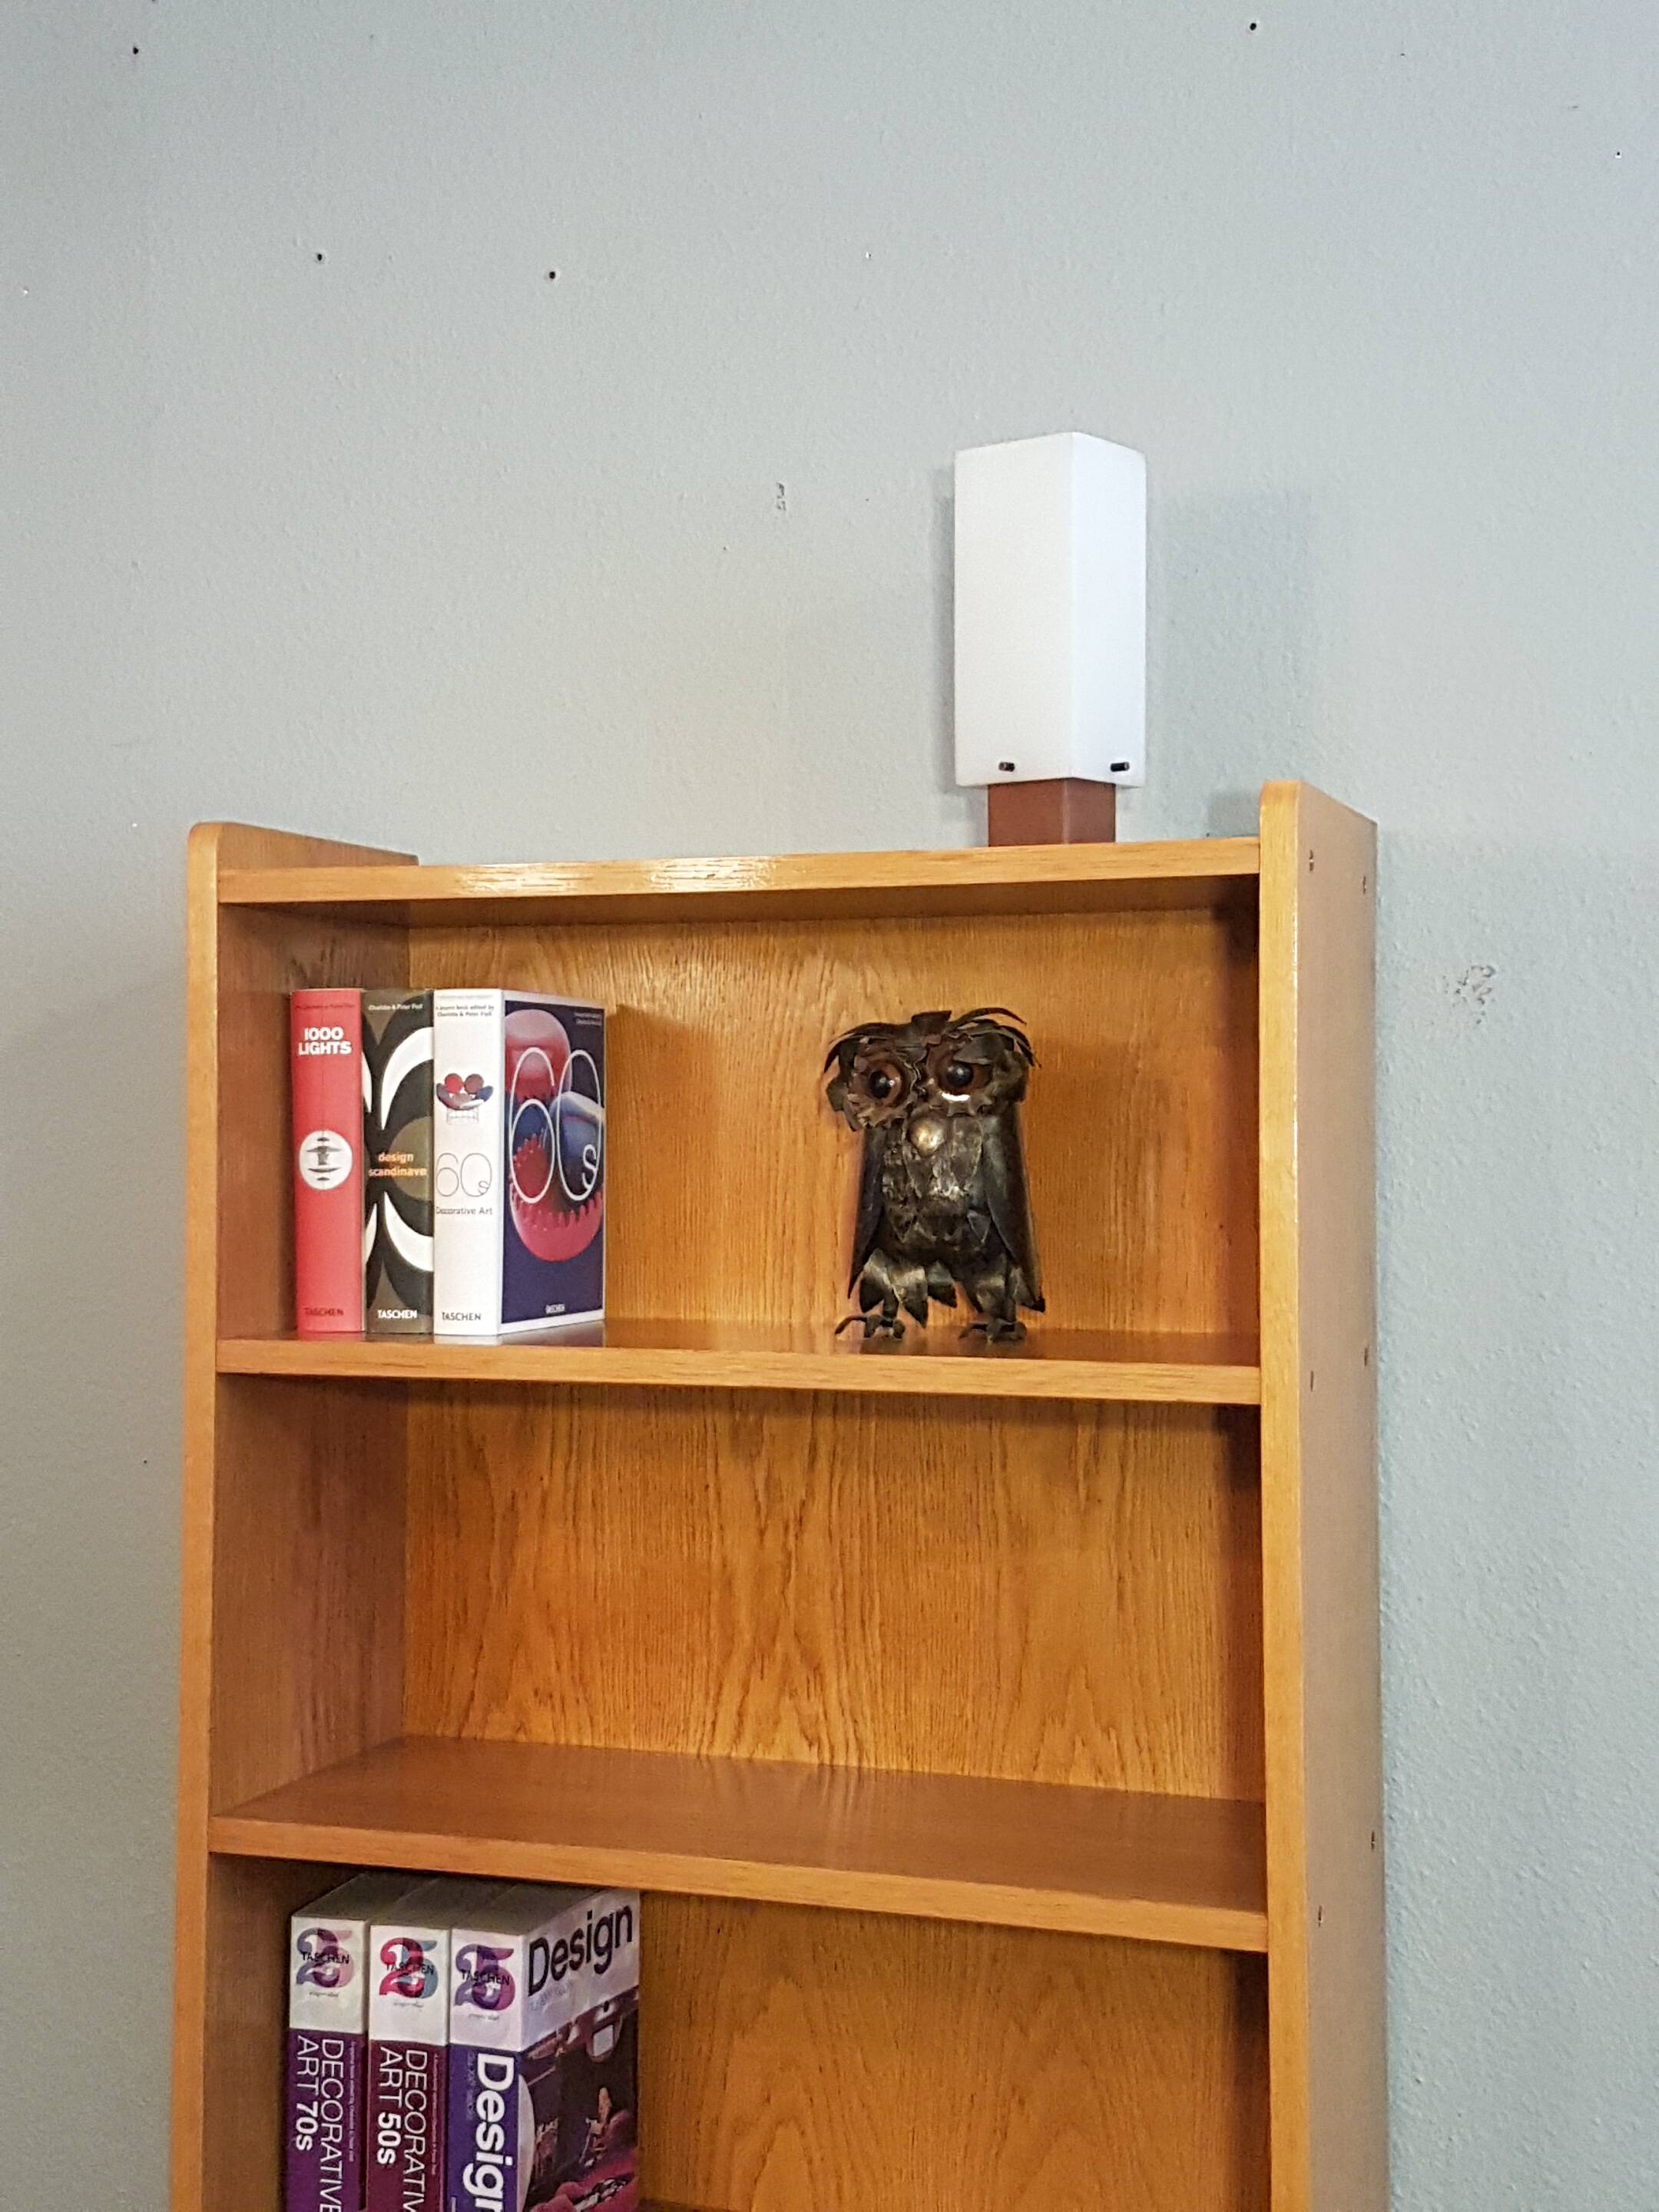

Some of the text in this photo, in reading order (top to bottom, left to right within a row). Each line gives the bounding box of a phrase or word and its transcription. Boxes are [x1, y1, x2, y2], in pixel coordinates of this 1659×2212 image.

[304, 1026, 344, 1041] 1000
[298, 1041, 352, 1056] LIGHTS
[378, 1152, 415, 1164] design
[368, 1167, 428, 1177] scandinave
[478, 1207, 494, 1215] Art
[377, 1309, 418, 1320] TASCHEN
[441, 1311, 482, 1322] TASCHEN
[301, 1951, 349, 1965] TASCHEN
[528, 1905, 633, 1997] Design
[461, 1969, 510, 1986] TASCHEN
[296, 2035, 320, 2151] ART 70s
[377, 2046, 403, 2165] ART 50s
